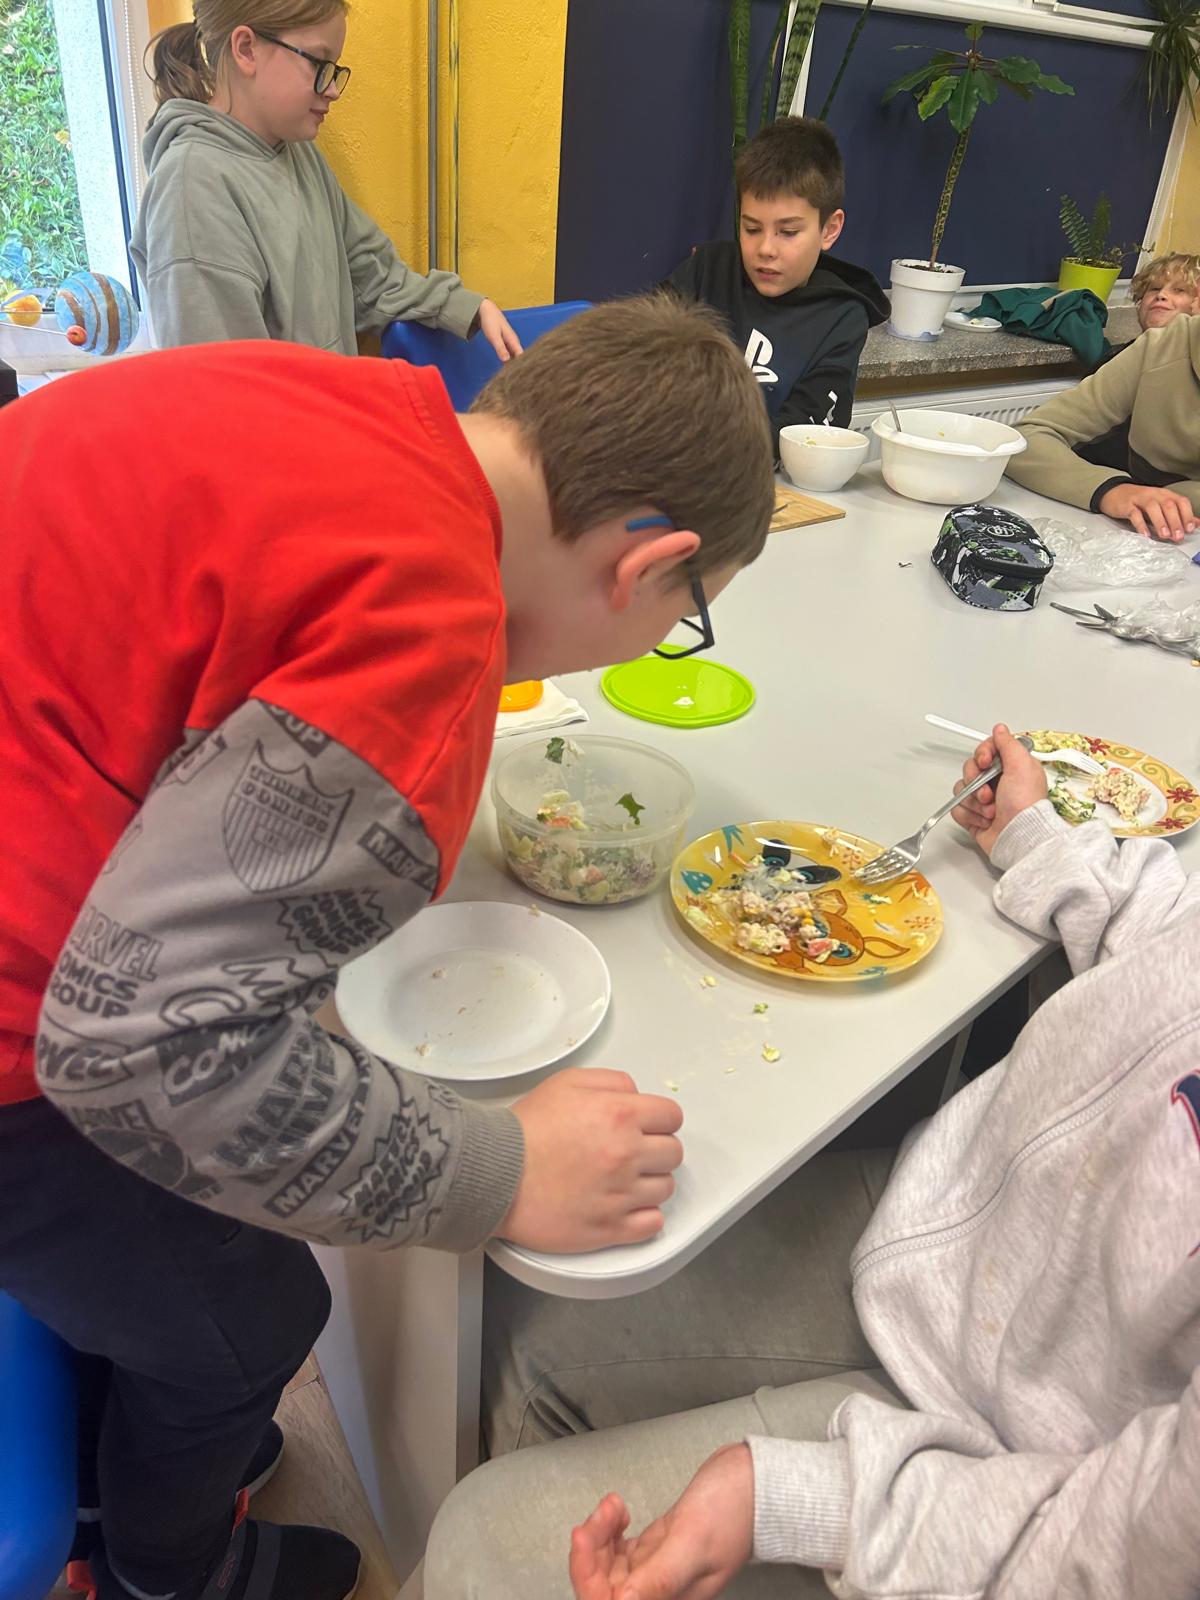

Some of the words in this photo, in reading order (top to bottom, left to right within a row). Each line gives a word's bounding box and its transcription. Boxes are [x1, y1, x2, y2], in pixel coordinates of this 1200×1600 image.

[70, 905, 164, 982] ARVEL
[51, 976, 130, 1018] ROUP
[58, 950, 139, 1002] OMICS
[273, 1101, 366, 1213] MARVEL
